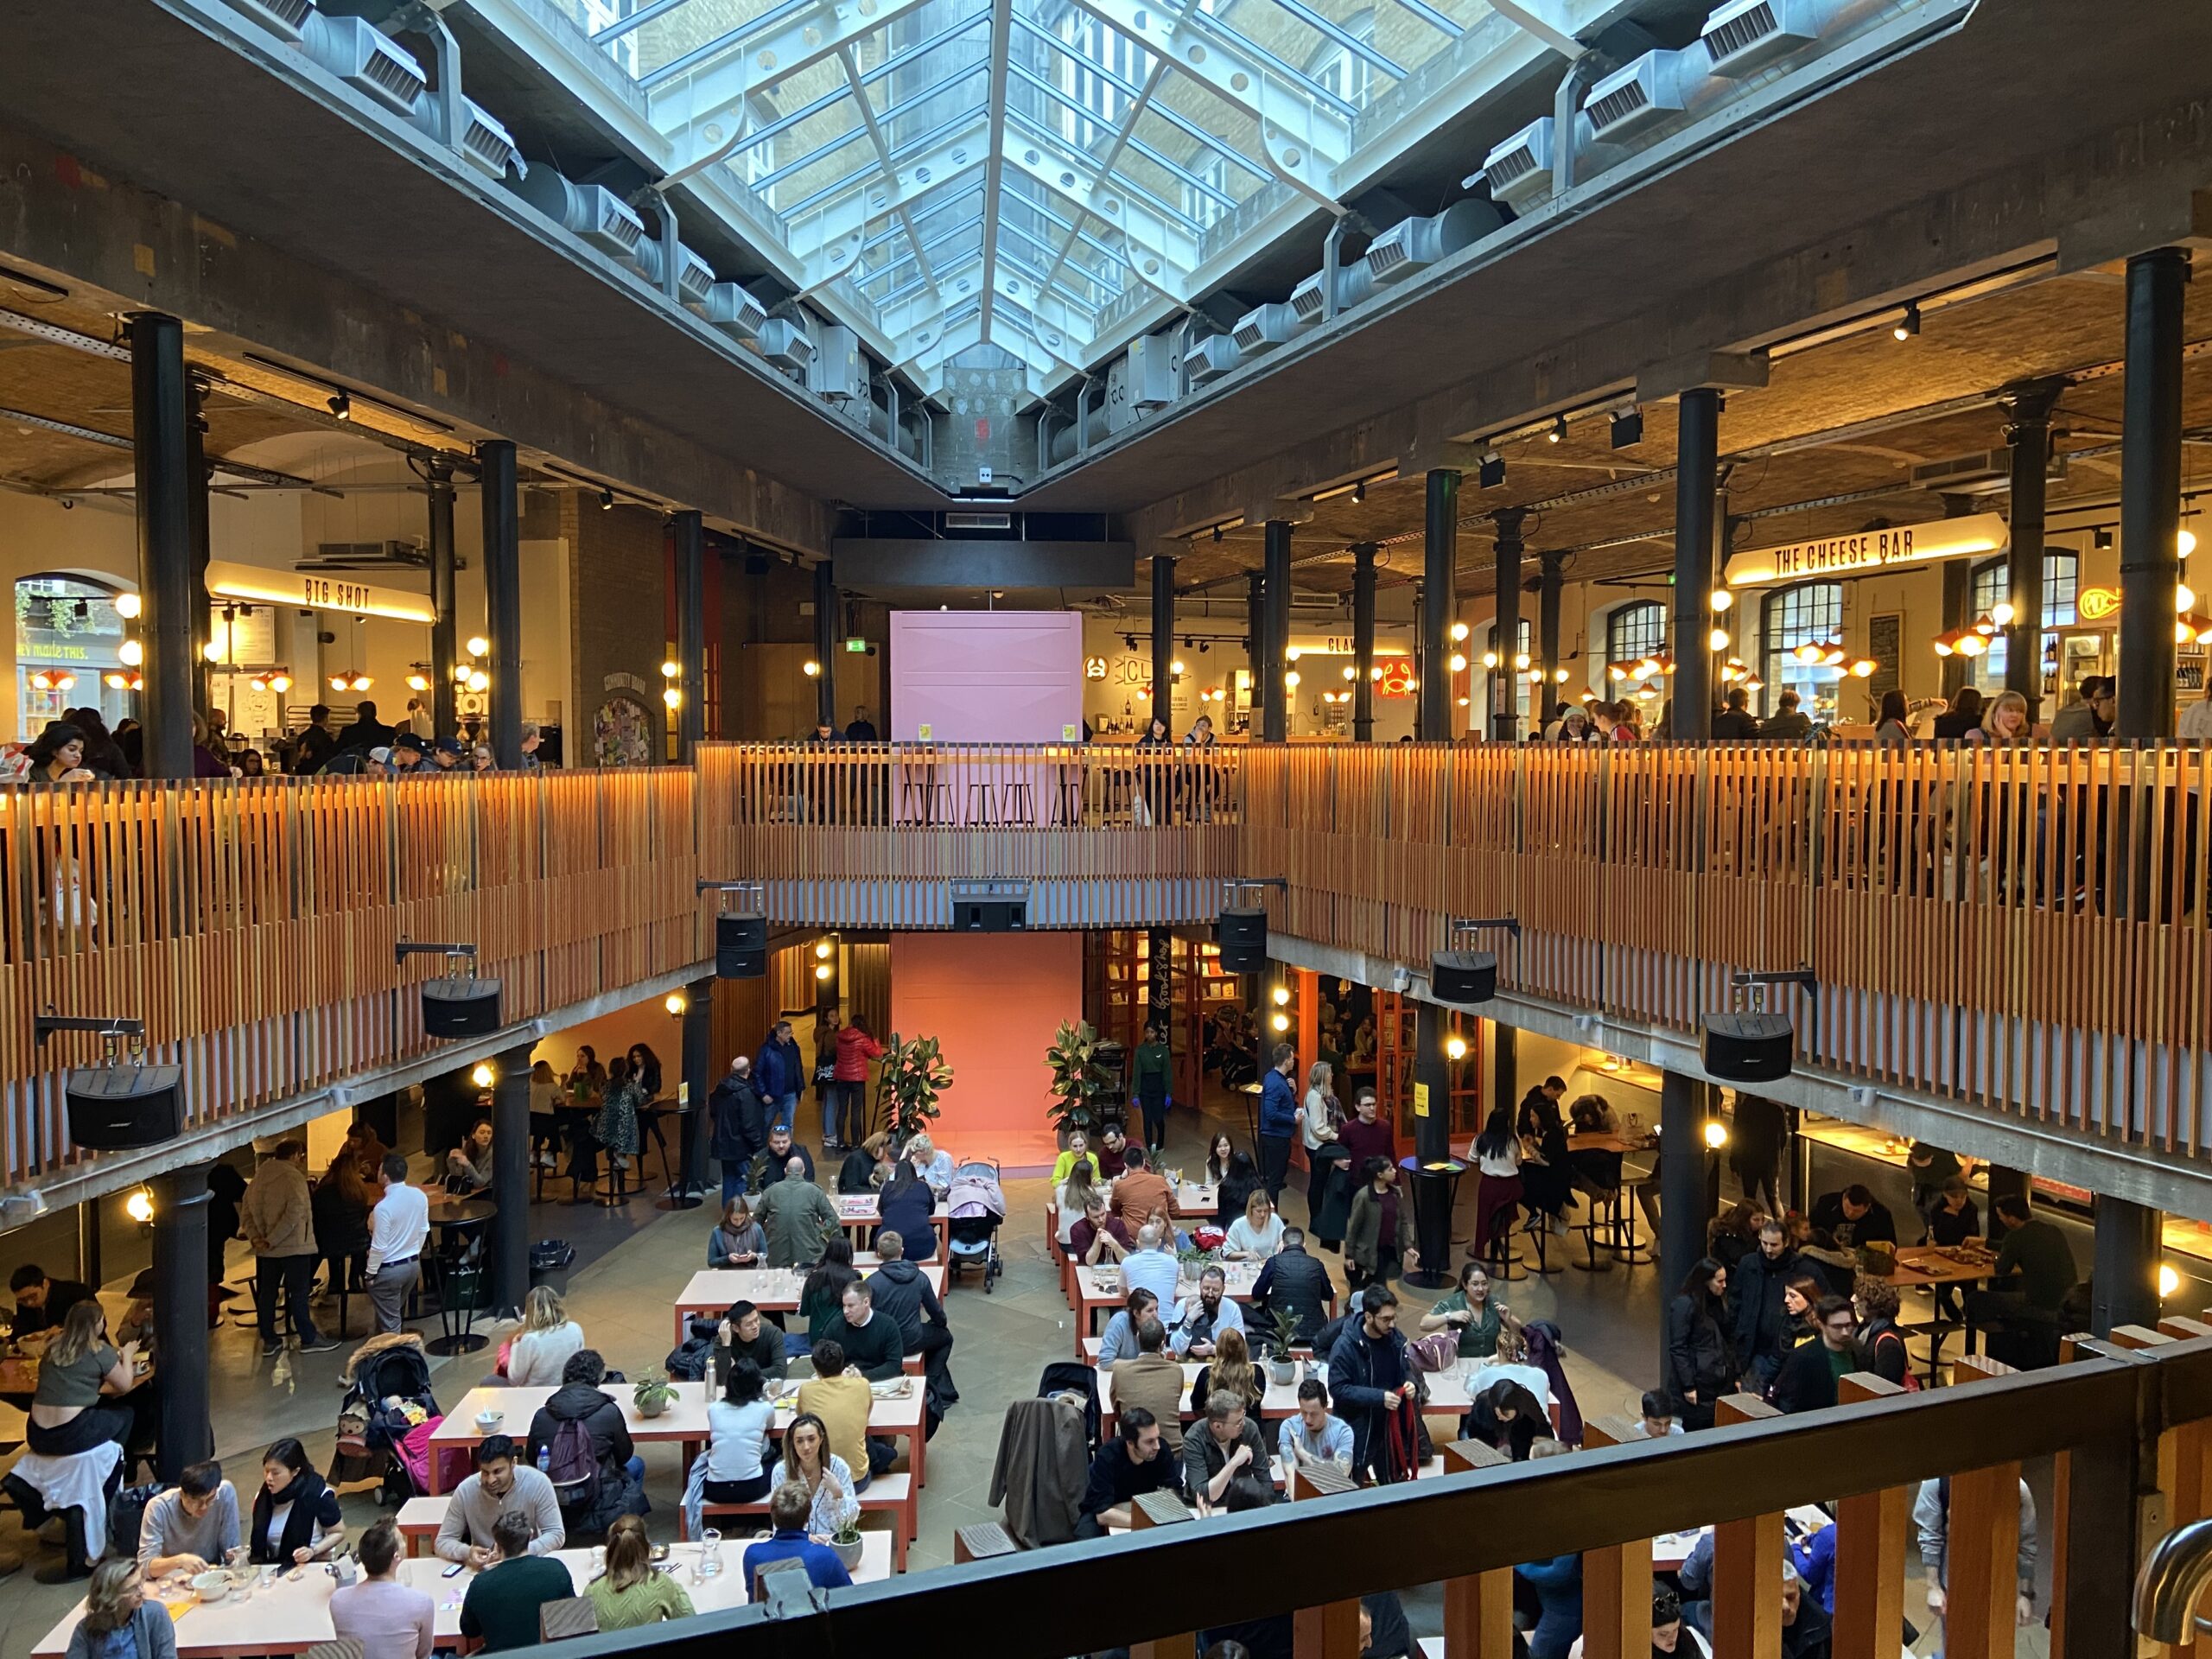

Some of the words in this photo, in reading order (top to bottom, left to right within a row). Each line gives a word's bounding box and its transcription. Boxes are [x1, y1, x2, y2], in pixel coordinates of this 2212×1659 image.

[1775, 548, 1800, 575] THE
[1807, 537, 1867, 569] CHEESE
[1879, 531, 1913, 560] BAR
[306, 579, 328, 603] BIG
[338, 583, 369, 609] SHOT
[33, 640, 63, 658] made
[62, 646, 89, 659] THIS.
